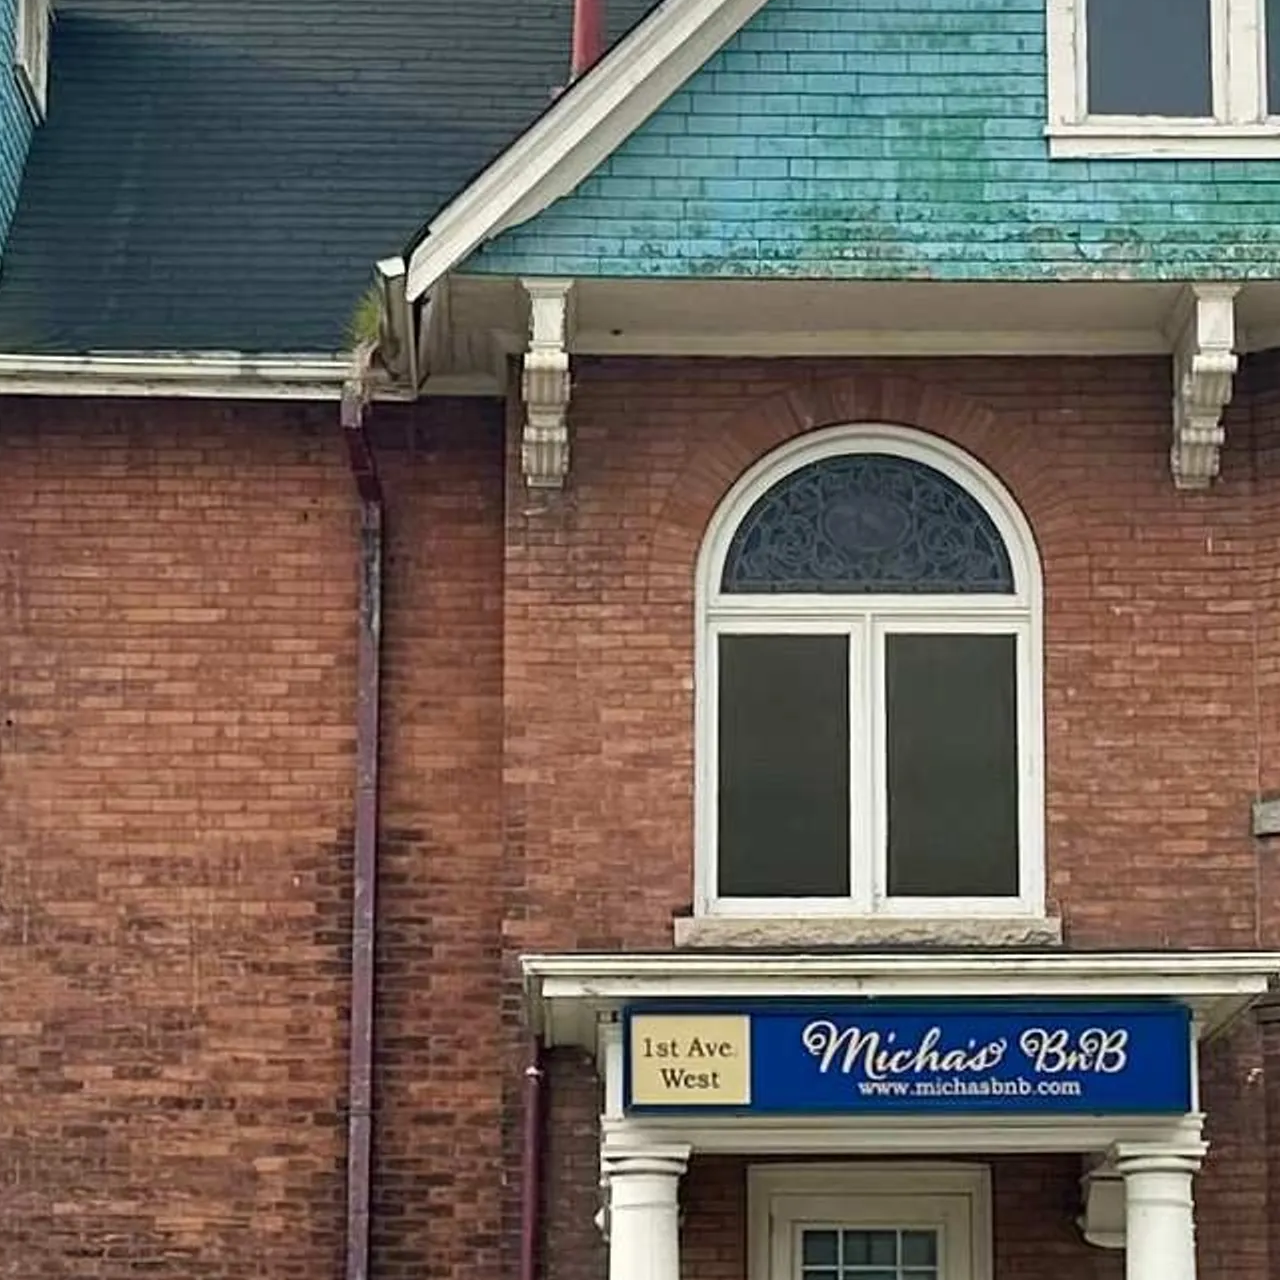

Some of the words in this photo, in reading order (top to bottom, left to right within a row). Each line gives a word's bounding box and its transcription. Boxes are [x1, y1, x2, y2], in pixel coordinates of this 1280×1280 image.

[643, 1037, 679, 1058] 1st
[802, 1020, 1008, 1080] Micha's
[1020, 1027, 1129, 1073] BnB
[660, 1068, 721, 1089] West
[857, 1076, 1082, 1096] www.michasbnb.com
